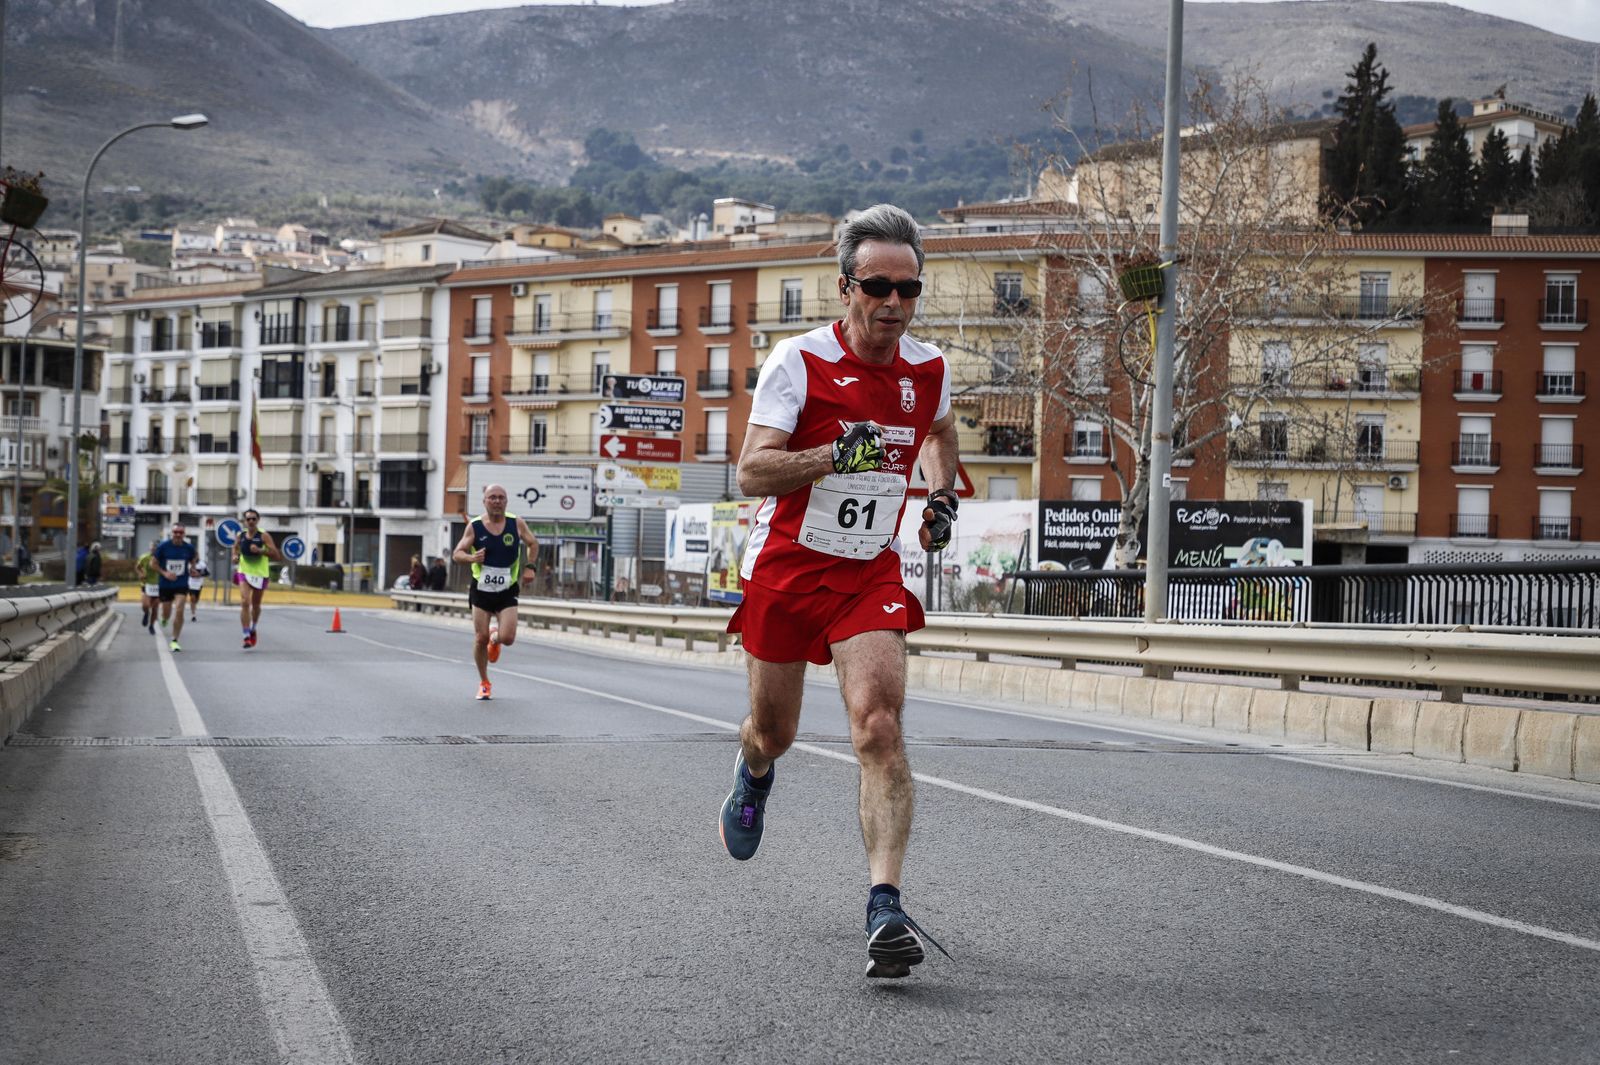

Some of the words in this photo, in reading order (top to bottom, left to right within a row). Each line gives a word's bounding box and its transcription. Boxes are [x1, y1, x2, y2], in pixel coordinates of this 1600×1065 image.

[641, 415, 653, 423] DEL
[668, 409, 681, 417] LOS
[837, 498, 877, 530] 61
[1045, 507, 1090, 523] Pedidos
[1044, 539, 1059, 550] Fácil,
[1058, 539, 1080, 549] cómodo
[1084, 539, 1102, 551] rápido
[1174, 543, 1224, 568] MENÚ
[484, 574, 505, 585] 840
